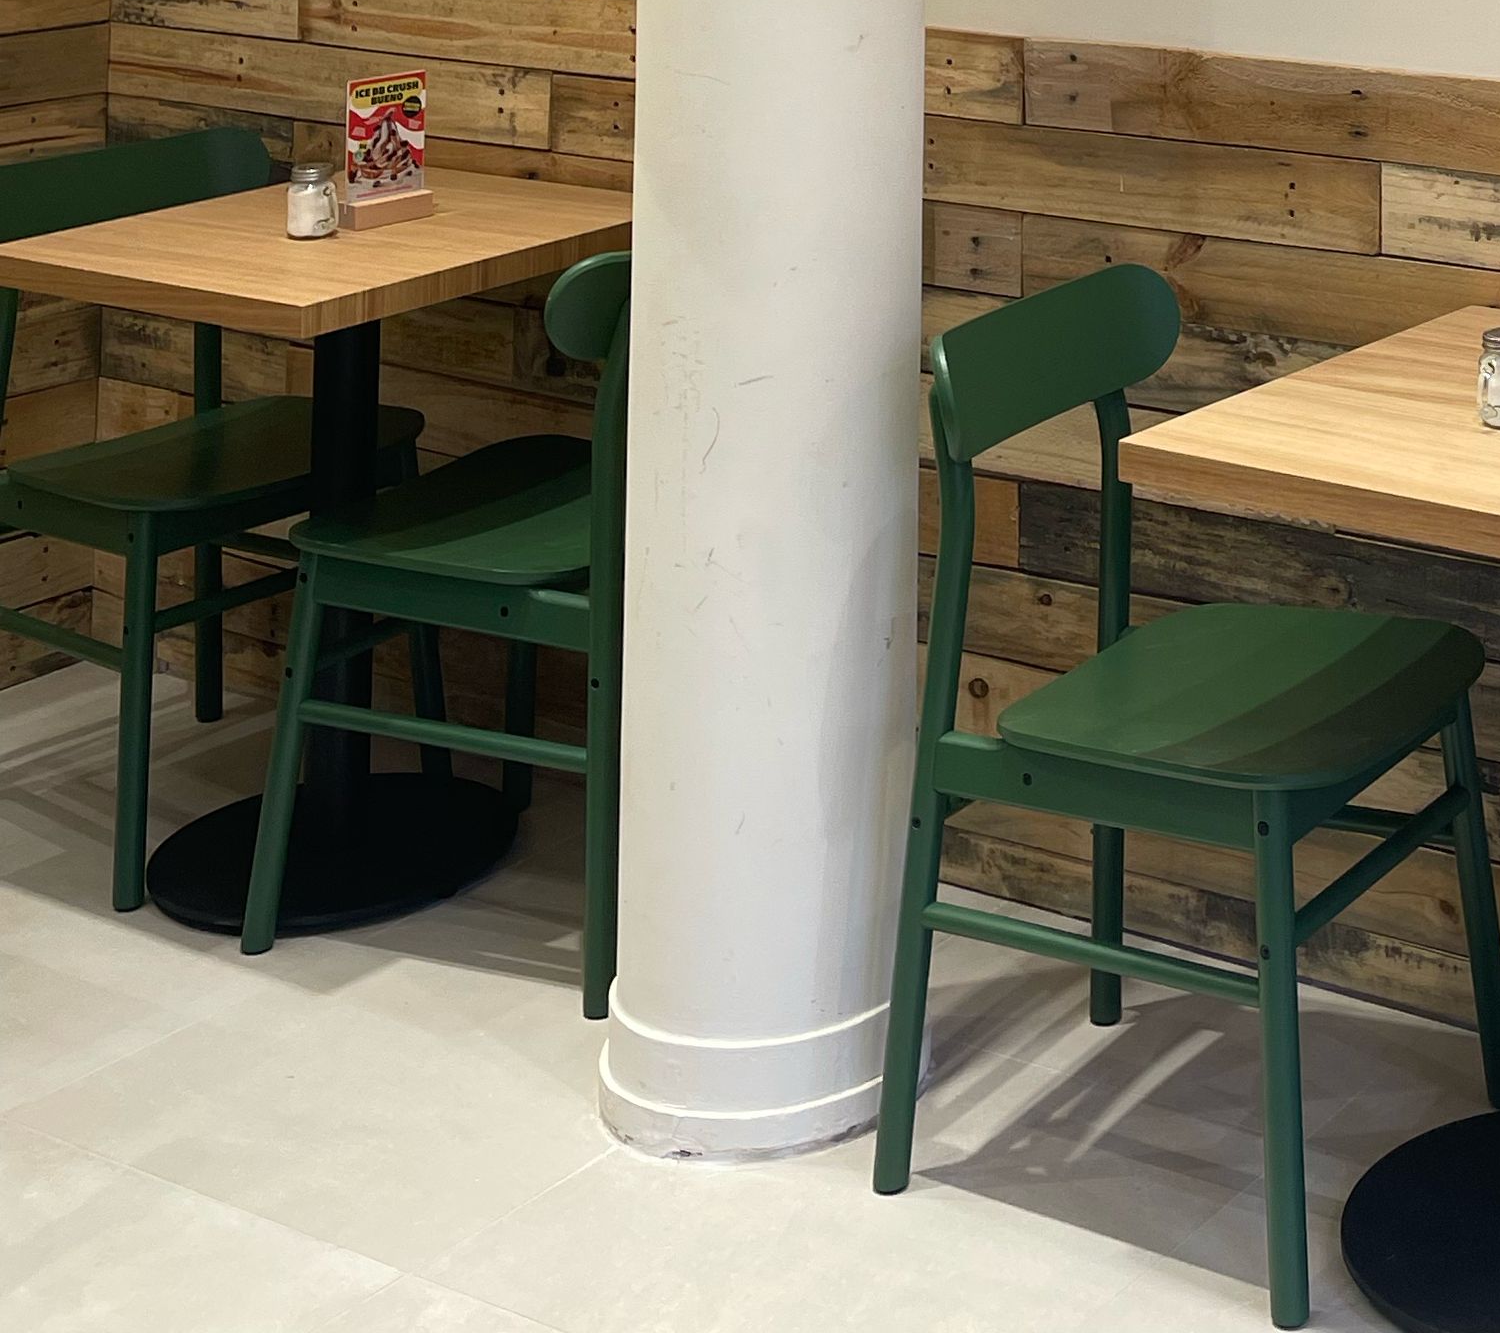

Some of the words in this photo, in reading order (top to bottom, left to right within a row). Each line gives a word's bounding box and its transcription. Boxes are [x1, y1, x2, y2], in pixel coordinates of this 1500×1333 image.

[355, 87, 371, 99] ICE
[387, 80, 419, 93] CRUSH
[371, 92, 403, 106] BUENO
